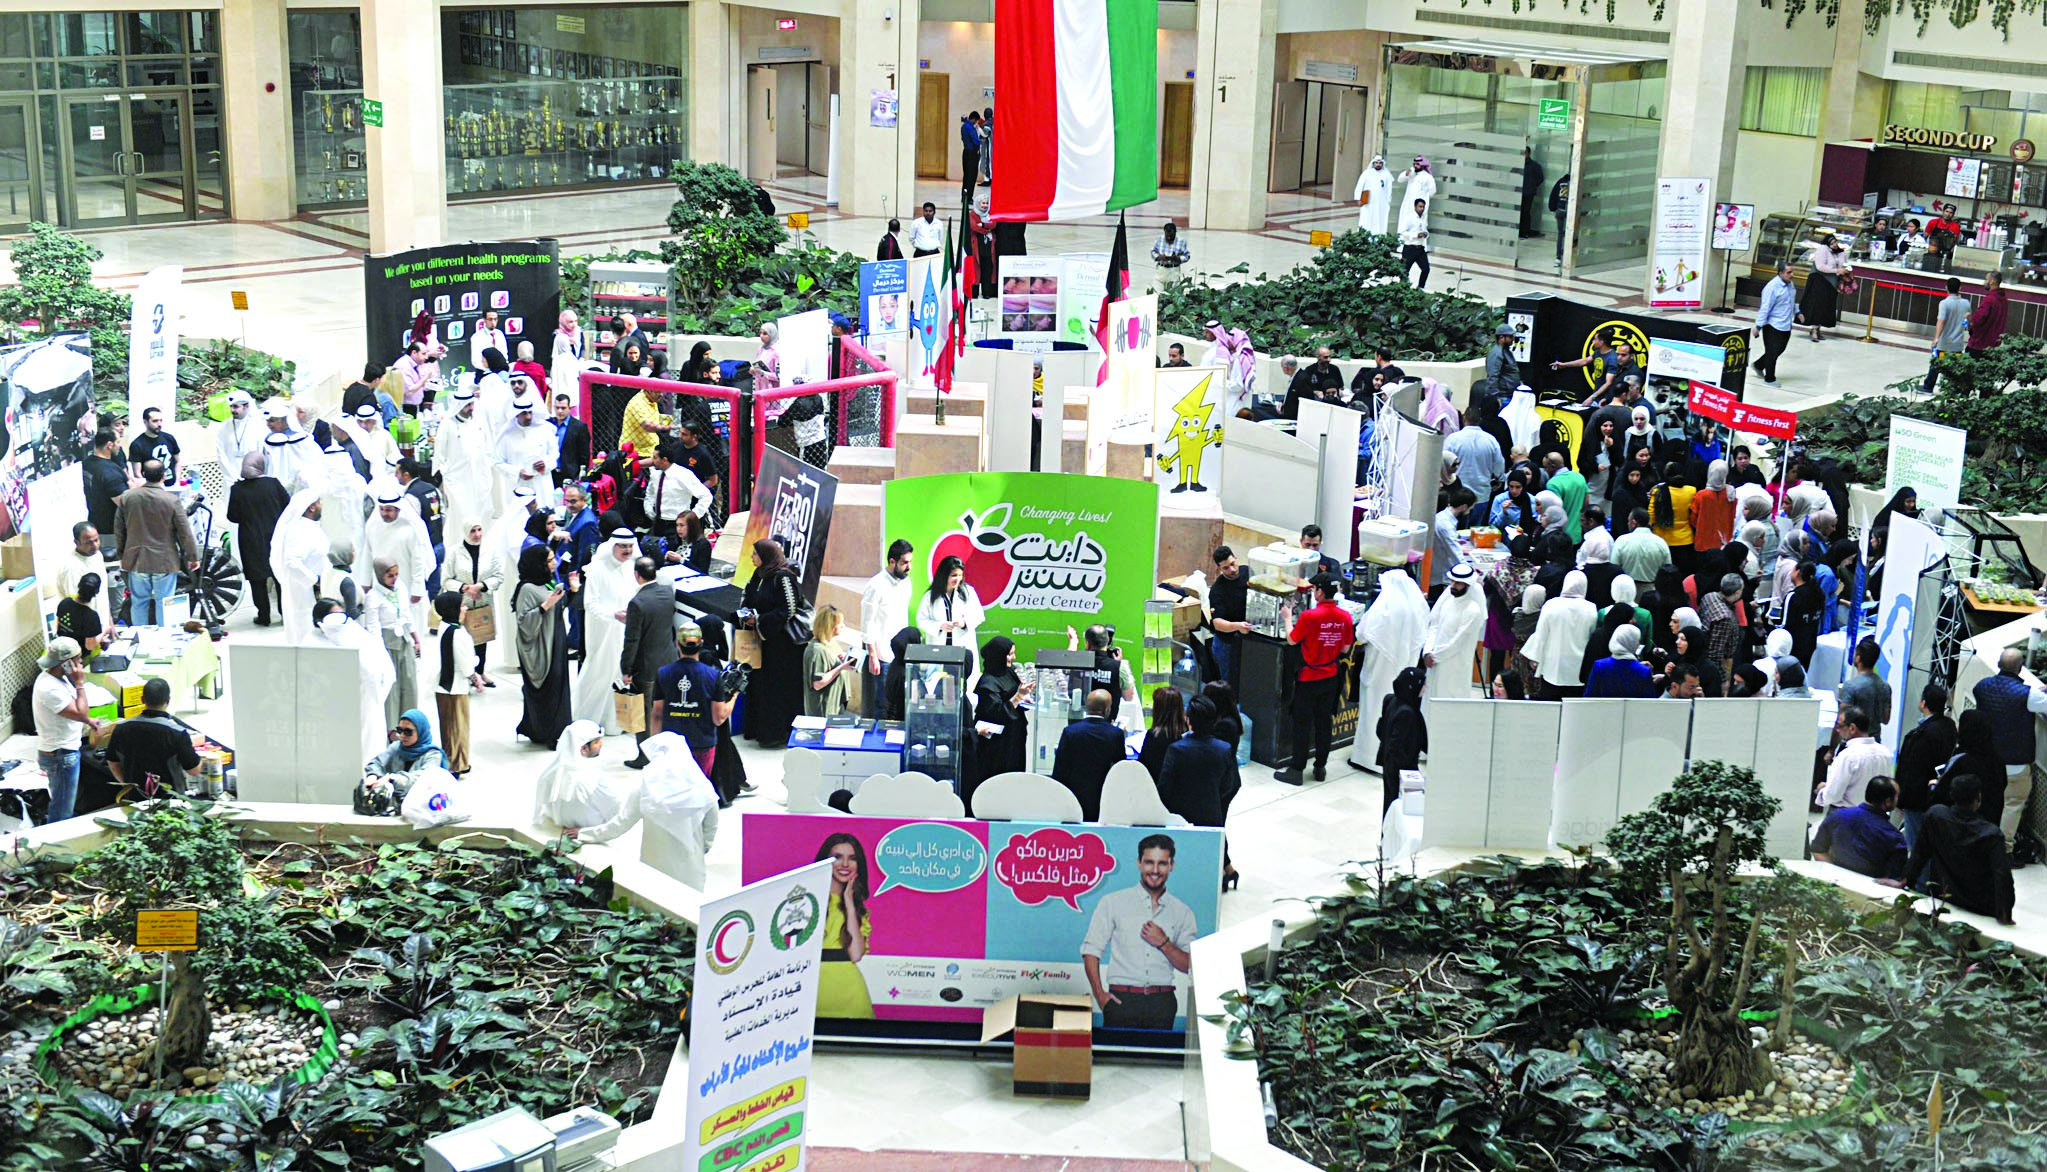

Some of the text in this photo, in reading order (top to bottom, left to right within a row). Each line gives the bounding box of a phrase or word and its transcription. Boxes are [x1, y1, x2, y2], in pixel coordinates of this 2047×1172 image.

[887, 73, 895, 90] 1
[1217, 85, 1227, 103] 1
[1884, 124, 1996, 152] SECOND CUP
[384, 267, 395, 279] We
[411, 260, 425, 275] you
[427, 256, 464, 271] different
[467, 253, 498, 266] health
[501, 253, 551, 266] programs
[410, 269, 504, 289] based on your needs
[1020, 505, 1113, 526] Changing Lives!
[1010, 535, 1103, 565] دايت
[1003, 568, 1102, 605] سنتر
[1015, 594, 1100, 610] Diet Center
[923, 842, 937, 858] كل
[939, 840, 961, 861] أدري
[1016, 839, 1084, 862] تدرين ماكو
[898, 861, 961, 879] في مكان واحد
[1062, 865, 1088, 887] مثل
[887, 970, 936, 978] WOMEN
[1043, 970, 1071, 980] Family
[717, 985, 741, 1008] الوطني
[771, 980, 802, 1002] قيادة
[724, 1025, 746, 1042] الطبية
[747, 1014, 774, 1033] الخدمات
[710, 1084, 794, 1136] قياس الضغط والسكر
[713, 1121, 790, 1166] فحص الدم CBC
